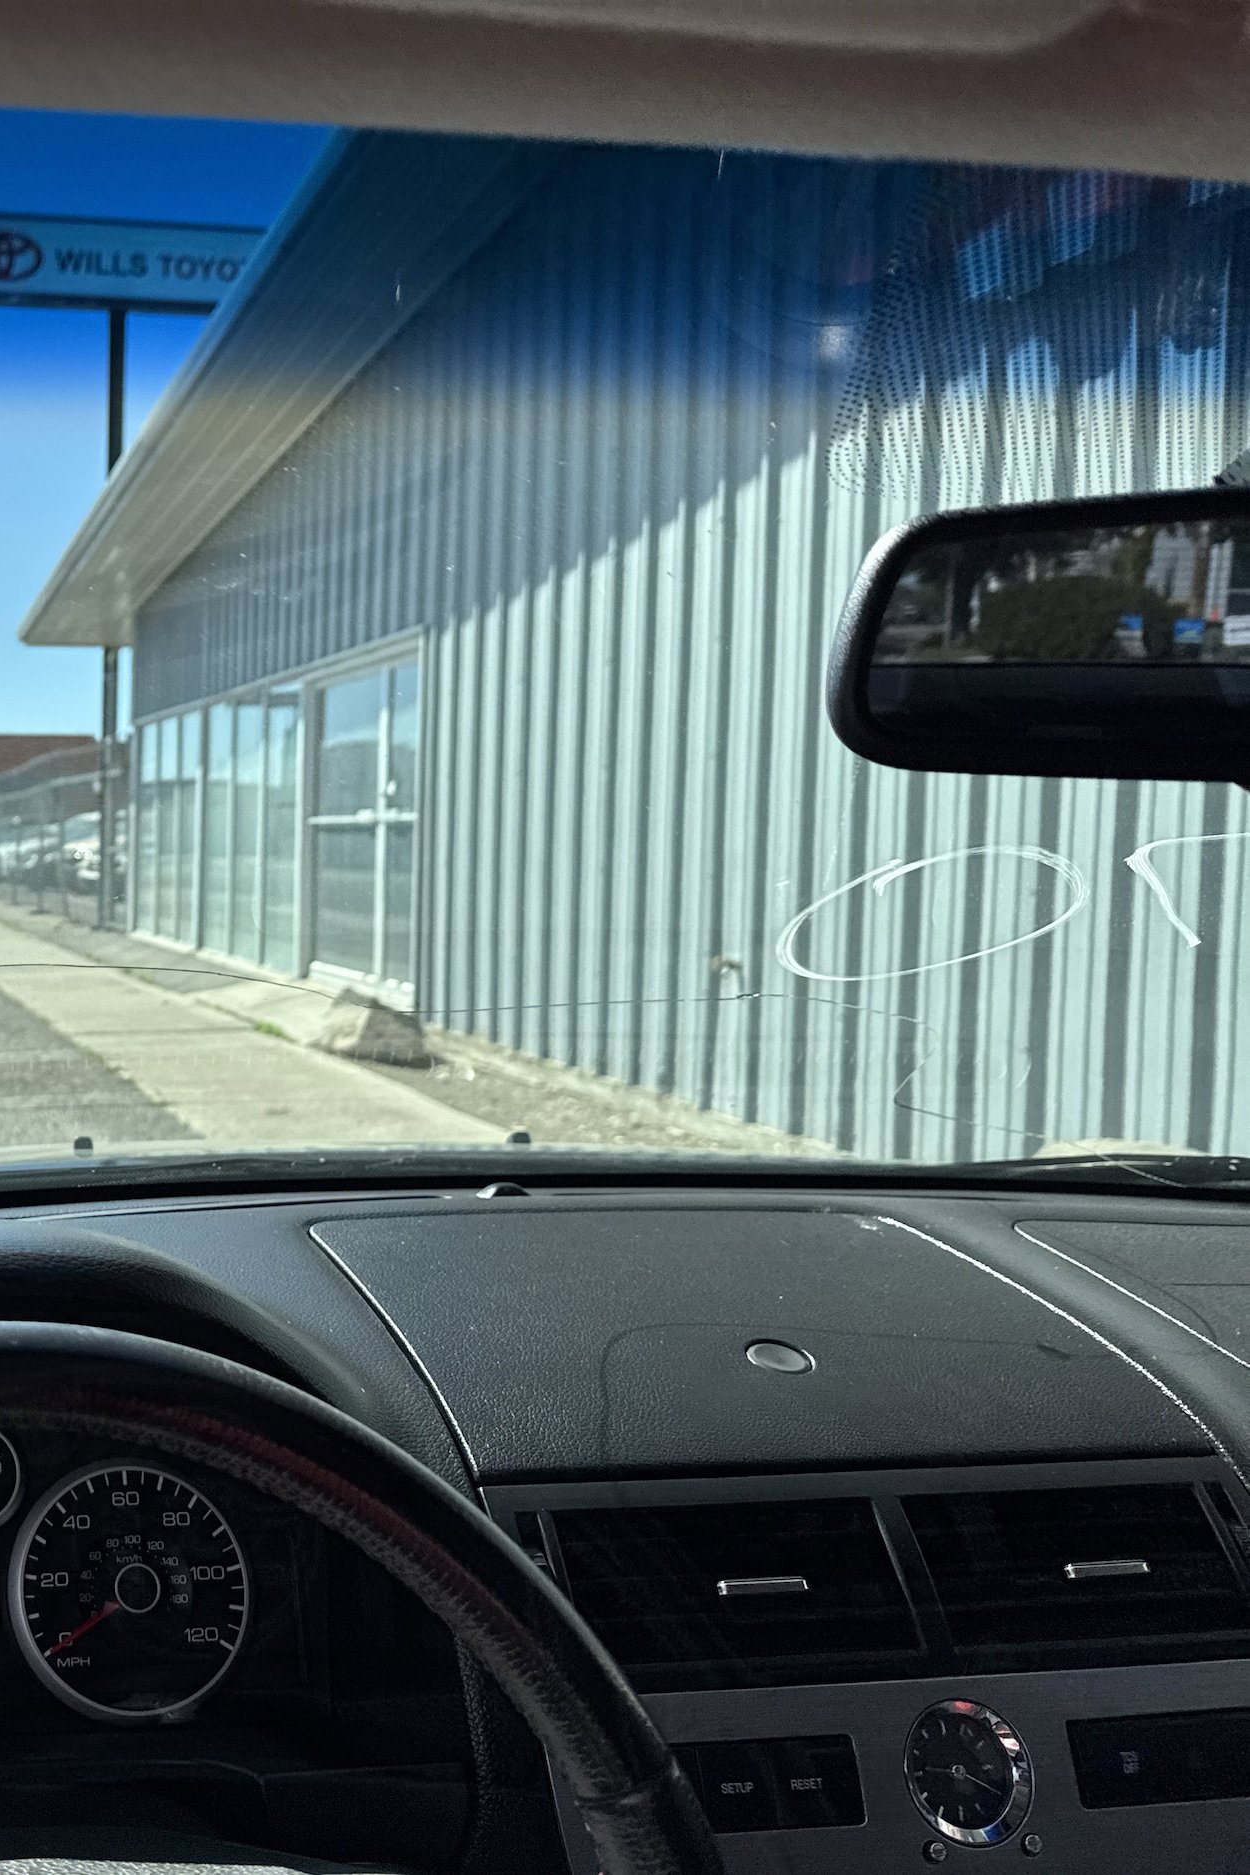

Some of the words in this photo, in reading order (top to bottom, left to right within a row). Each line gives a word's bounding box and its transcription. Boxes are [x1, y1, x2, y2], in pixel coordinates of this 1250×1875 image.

[54, 249, 149, 278] WILLS
[158, 252, 247, 283] TOYO
[111, 1491, 140, 1506] 60
[62, 1515, 91, 1530] 40
[162, 1511, 191, 1526] 80
[106, 1539, 119, 1548] 80
[124, 1535, 141, 1544] 100
[147, 1540, 164, 1550] 120
[89, 1551, 101, 1560] 60
[116, 1554, 143, 1563] km/h
[162, 1557, 179, 1566] 140
[80, 1570, 93, 1579] 40
[189, 1565, 225, 1580] 100
[40, 1572, 69, 1587] 20
[170, 1575, 187, 1584] 160
[79, 1593, 91, 1602] 20
[171, 1594, 188, 1603] 180
[183, 1627, 219, 1642] 120
[57, 1657, 91, 1668] MPH
[720, 1781, 754, 1794] SETUP
[790, 1778, 823, 1790] RESET
